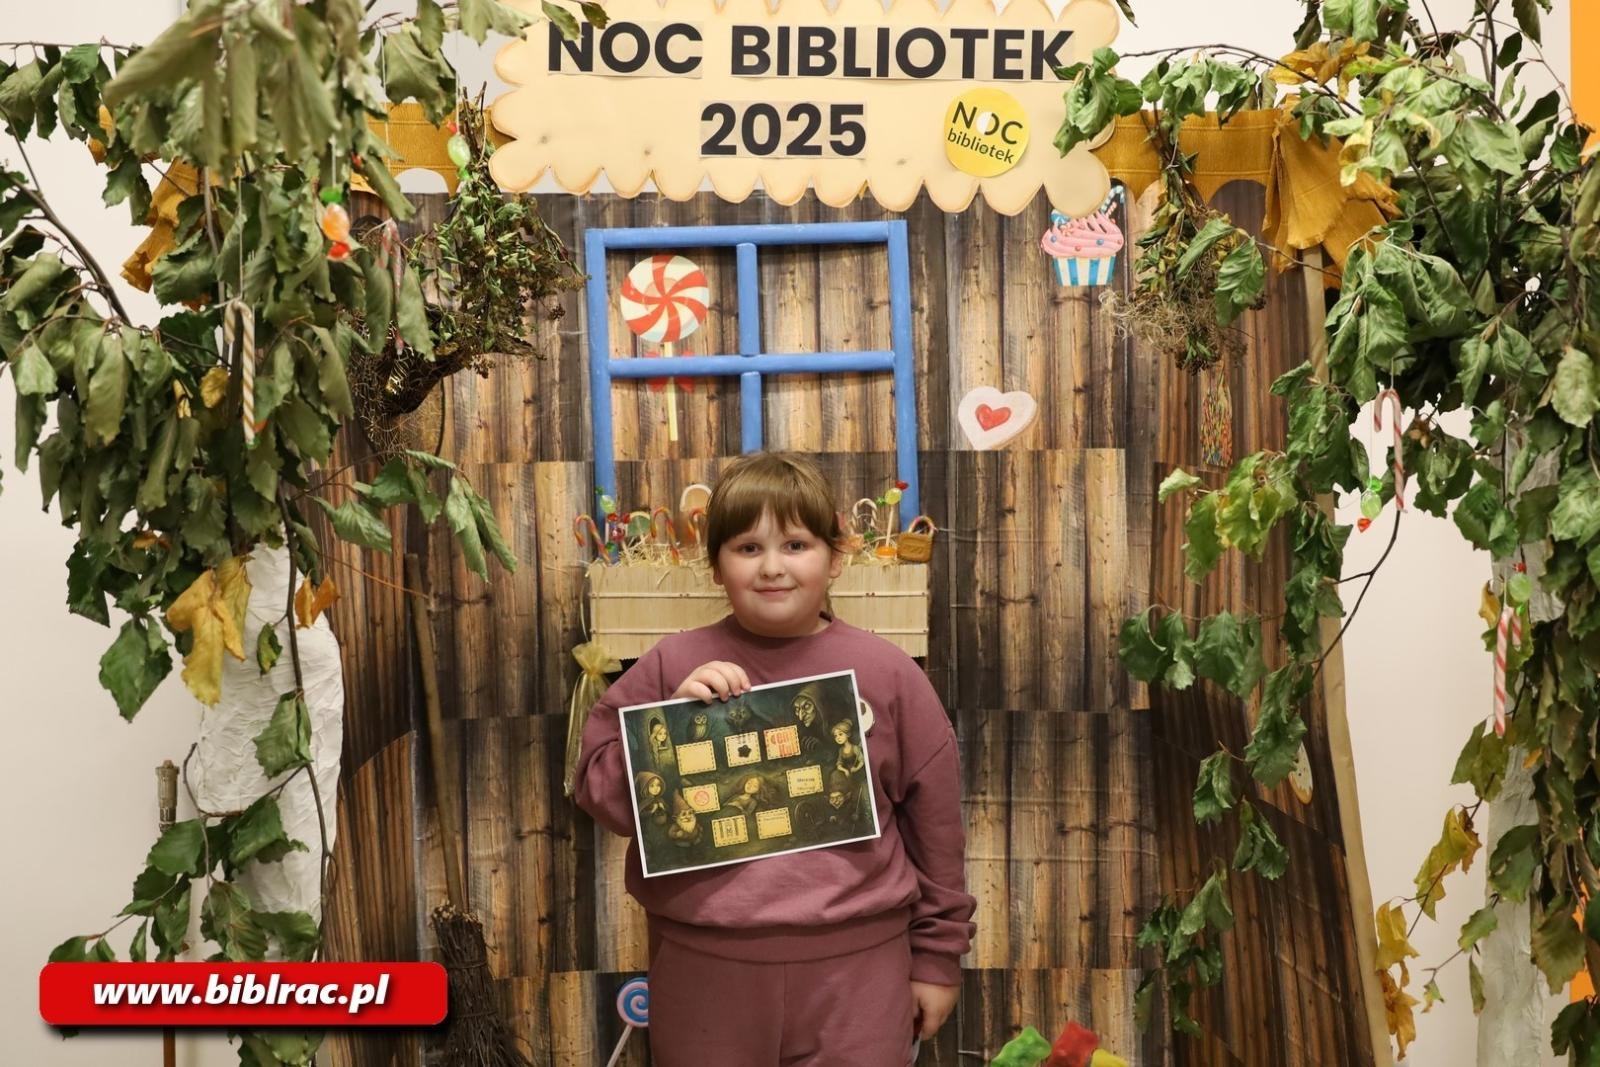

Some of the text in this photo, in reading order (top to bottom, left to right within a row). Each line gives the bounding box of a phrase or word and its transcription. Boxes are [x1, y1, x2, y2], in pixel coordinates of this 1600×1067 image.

[548, 21, 1075, 81] NOC BIBLIOTEK
[700, 102, 867, 157] 2025
[947, 127, 1015, 164] bibliotek
[952, 101, 1023, 145] NOC
